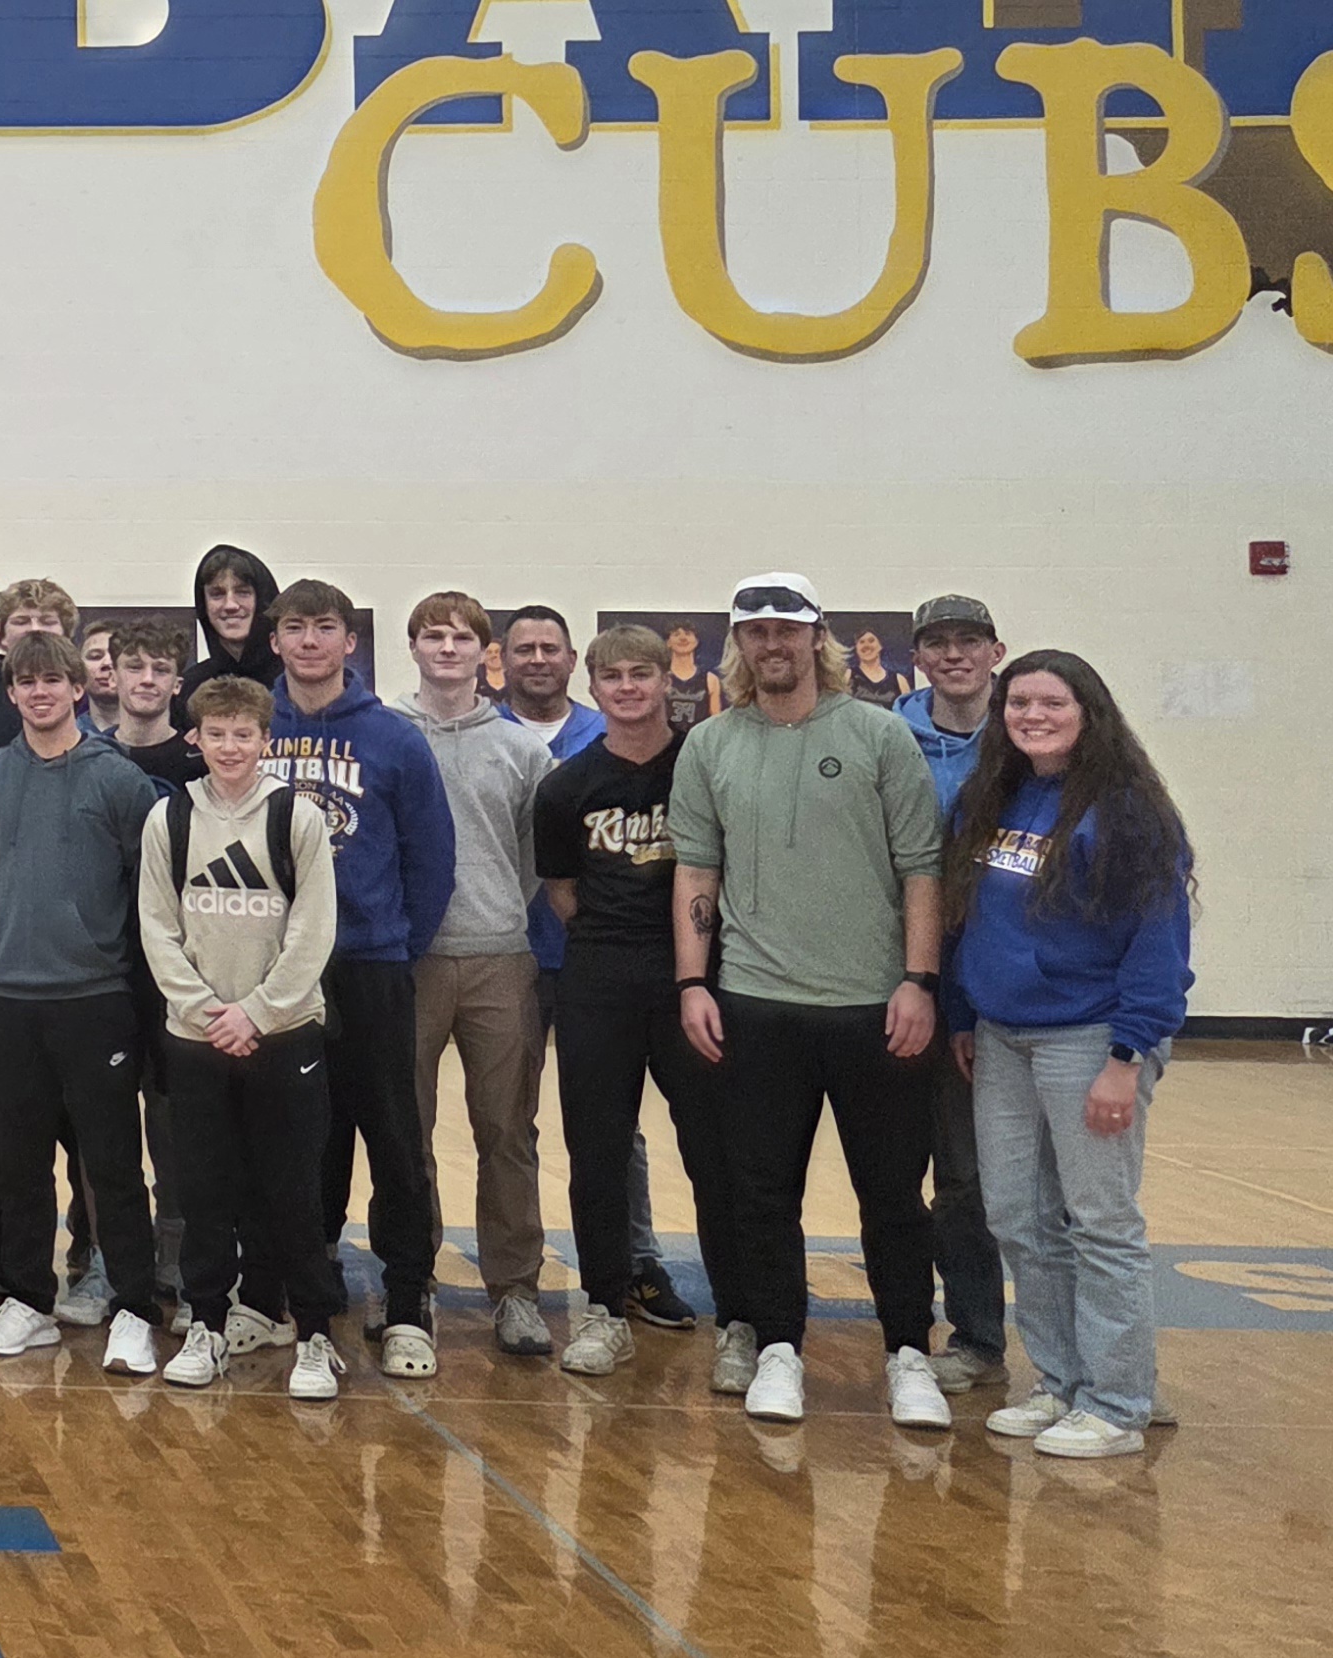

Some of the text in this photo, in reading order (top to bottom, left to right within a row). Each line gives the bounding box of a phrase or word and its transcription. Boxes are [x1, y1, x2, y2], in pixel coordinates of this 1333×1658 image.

[312, 37, 1333, 369] CUB
[261, 736, 355, 760] KIMBALL
[256, 758, 364, 798] OOTBALL
[184, 887, 285, 918] adidas
